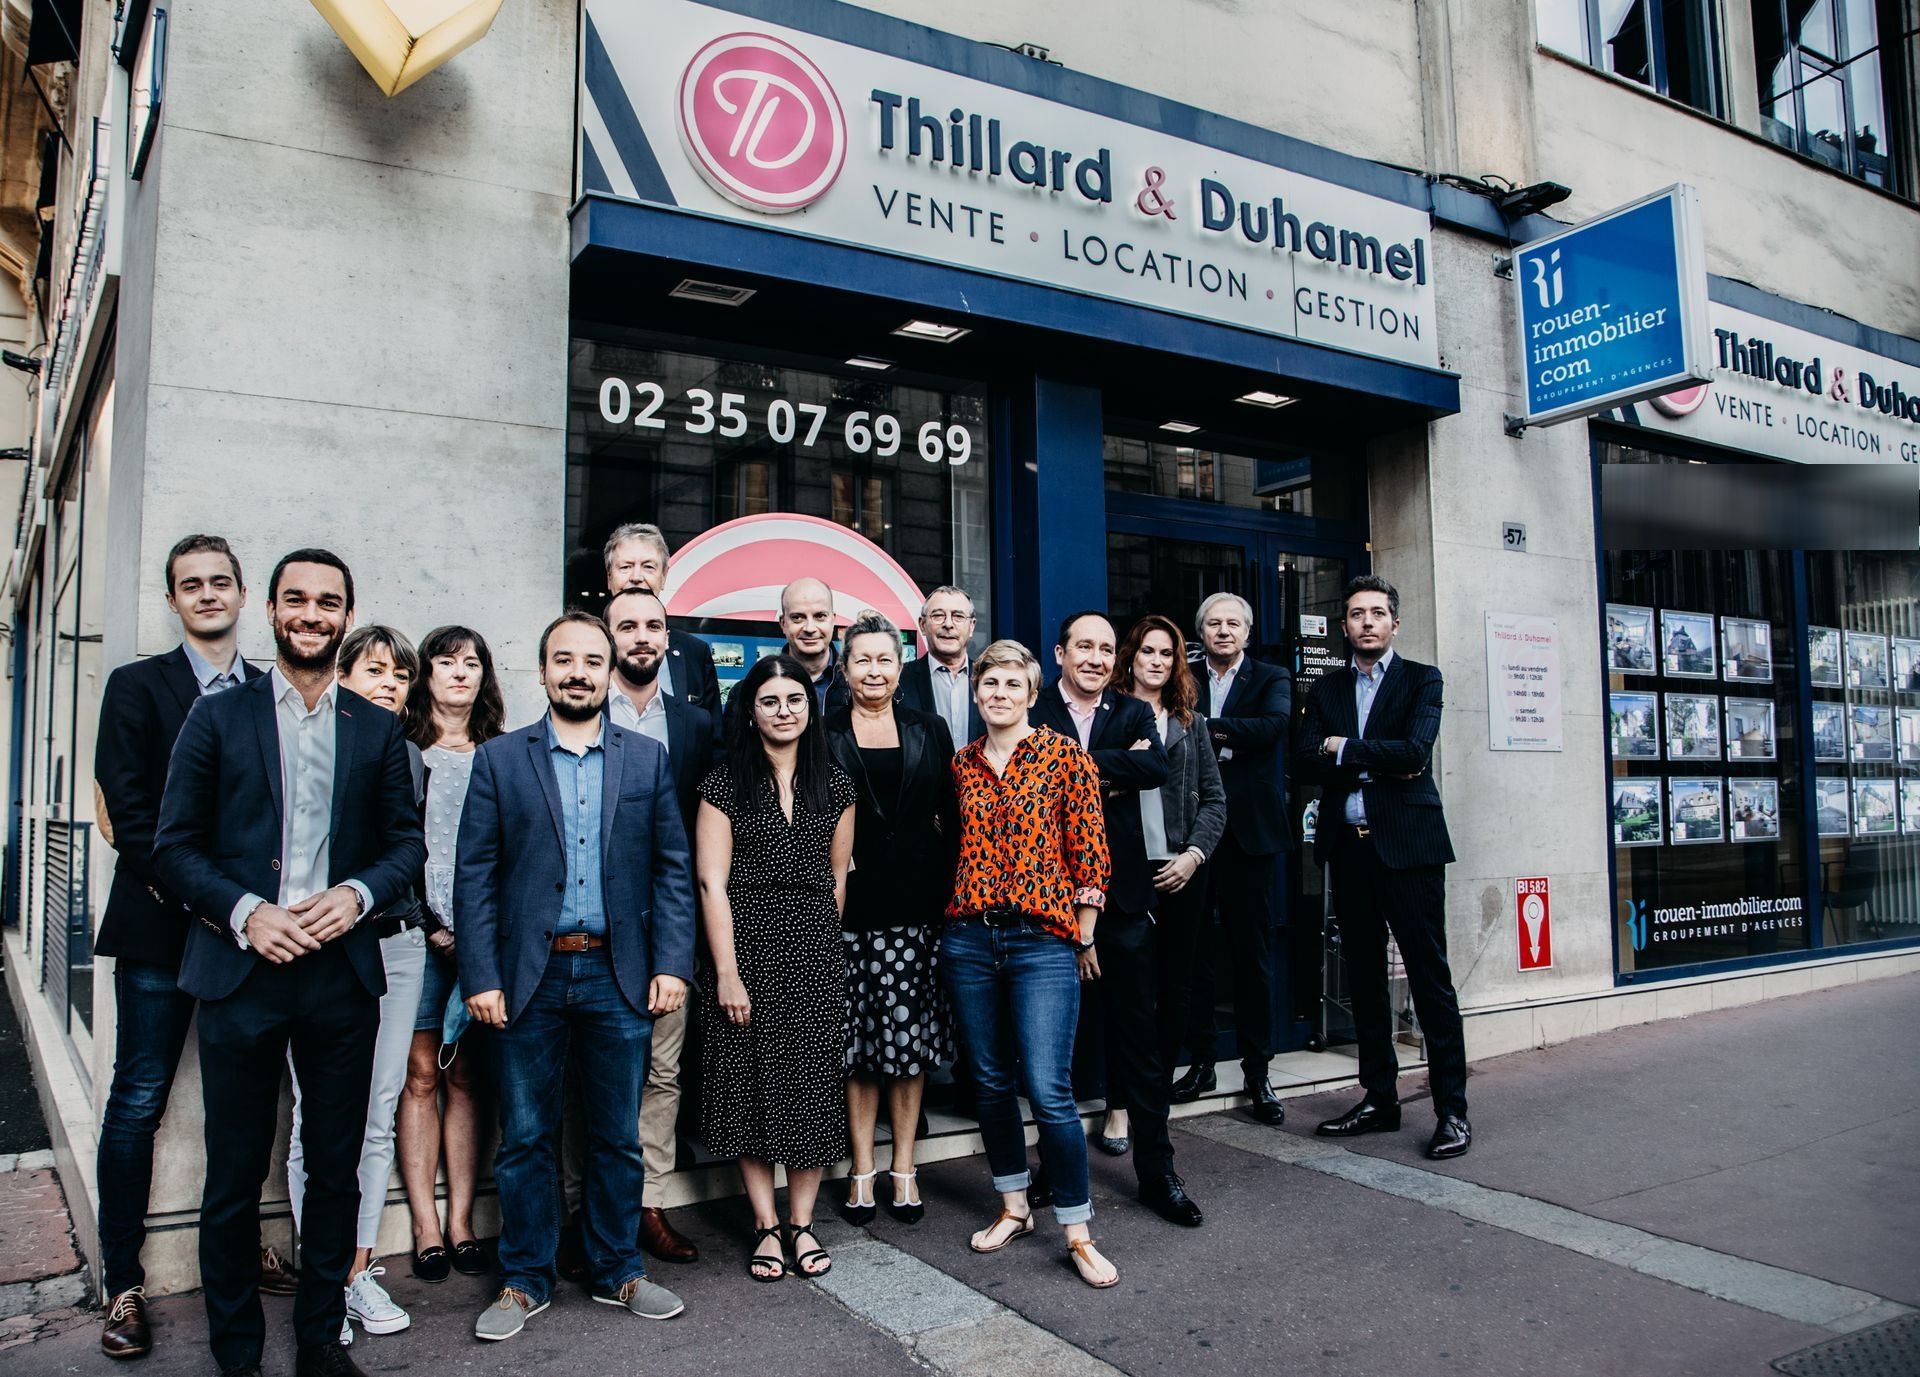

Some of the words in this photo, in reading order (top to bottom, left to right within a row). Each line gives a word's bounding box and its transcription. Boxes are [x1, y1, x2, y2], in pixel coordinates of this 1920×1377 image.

[870, 88, 1112, 203] Thillard
[1138, 166, 1178, 220] &
[1200, 177, 1426, 286] Duhamel
[872, 184, 1005, 244] VENTE
[1063, 229, 1248, 301] LOCATION
[1295, 287, 1420, 341] GESTION
[1532, 303, 1611, 339] rouen-
[1534, 307, 1667, 365] immobilier
[1535, 358, 1592, 389] .com
[1536, 378, 1605, 402] GROUPEMENT
[1611, 357, 1673, 381] D'AGENCES
[1714, 328, 1822, 395] Thillard
[1831, 367, 1850, 403] &
[599, 377, 666, 429] 02
[685, 388, 748, 438] 35
[767, 399, 827, 447] 07
[844, 410, 901, 457] 69
[918, 421, 972, 466] 69
[1715, 392, 1773, 427] VENTE
[1797, 413, 1881, 454] LOCATION
[1303, 646, 1330, 655] rouen-
[1303, 655, 1346, 666] immobilier
[1304, 667, 1323, 675] .com
[1517, 880, 1528, 894] BI
[1530, 880, 1547, 893] 582
[1653, 896, 1802, 924] rouen-immobilier.com
[1653, 923, 1735, 942] GROUPEMENT
